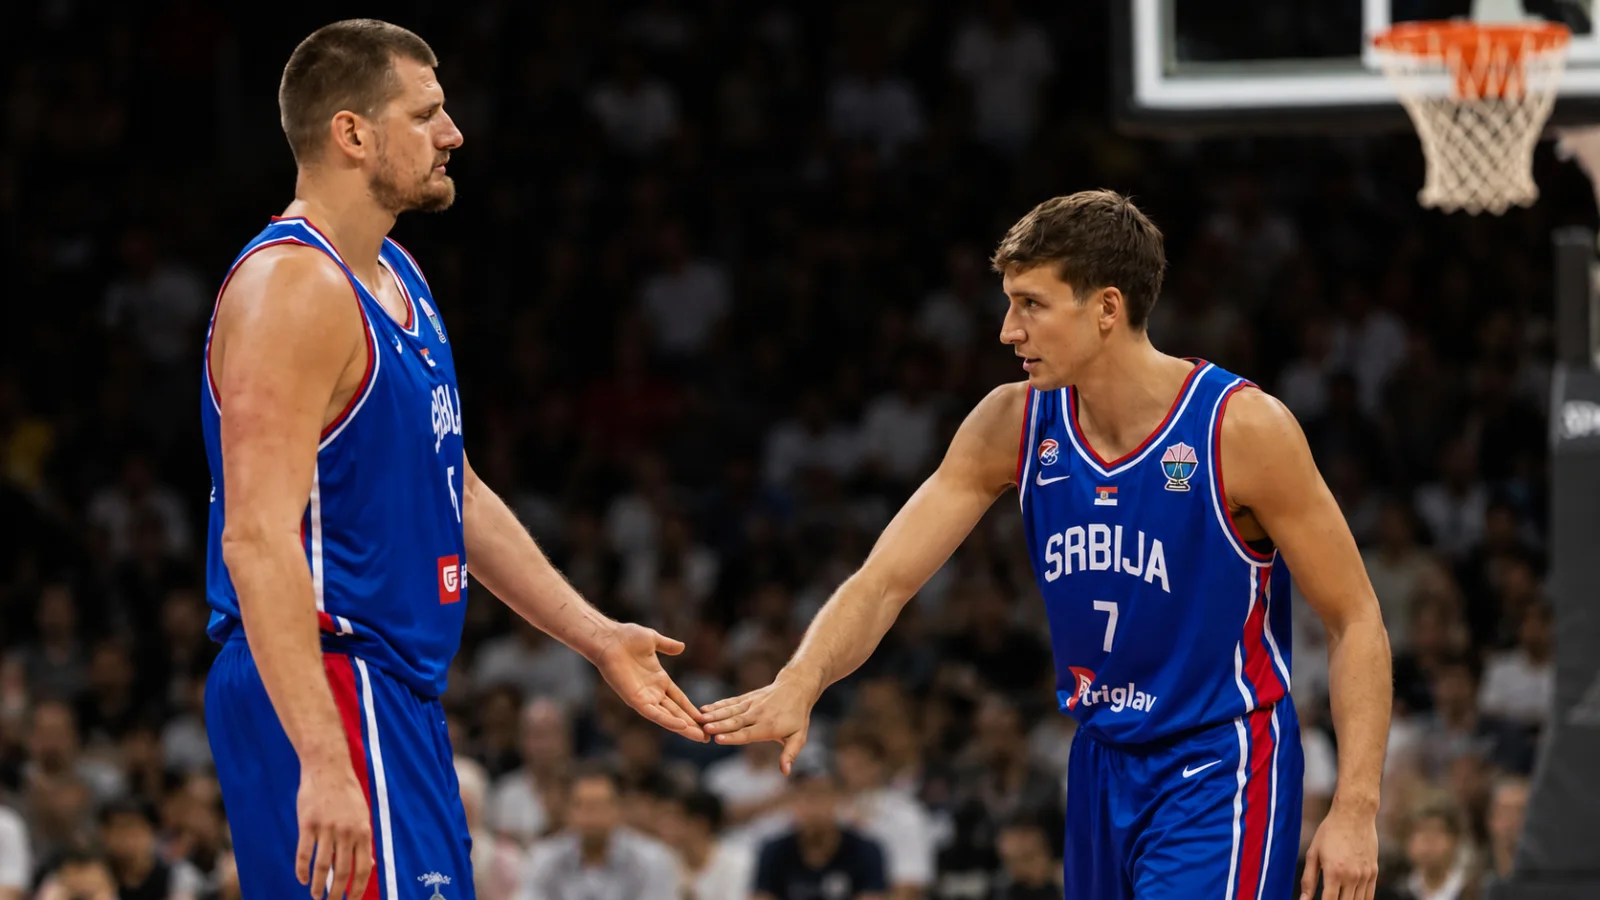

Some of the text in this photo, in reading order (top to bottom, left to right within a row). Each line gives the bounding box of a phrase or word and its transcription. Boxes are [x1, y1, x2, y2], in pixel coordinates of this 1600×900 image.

[1044, 523, 1171, 593] SRBIJA
[1093, 600, 1119, 653] 7
[1082, 682, 1157, 713] triglav
